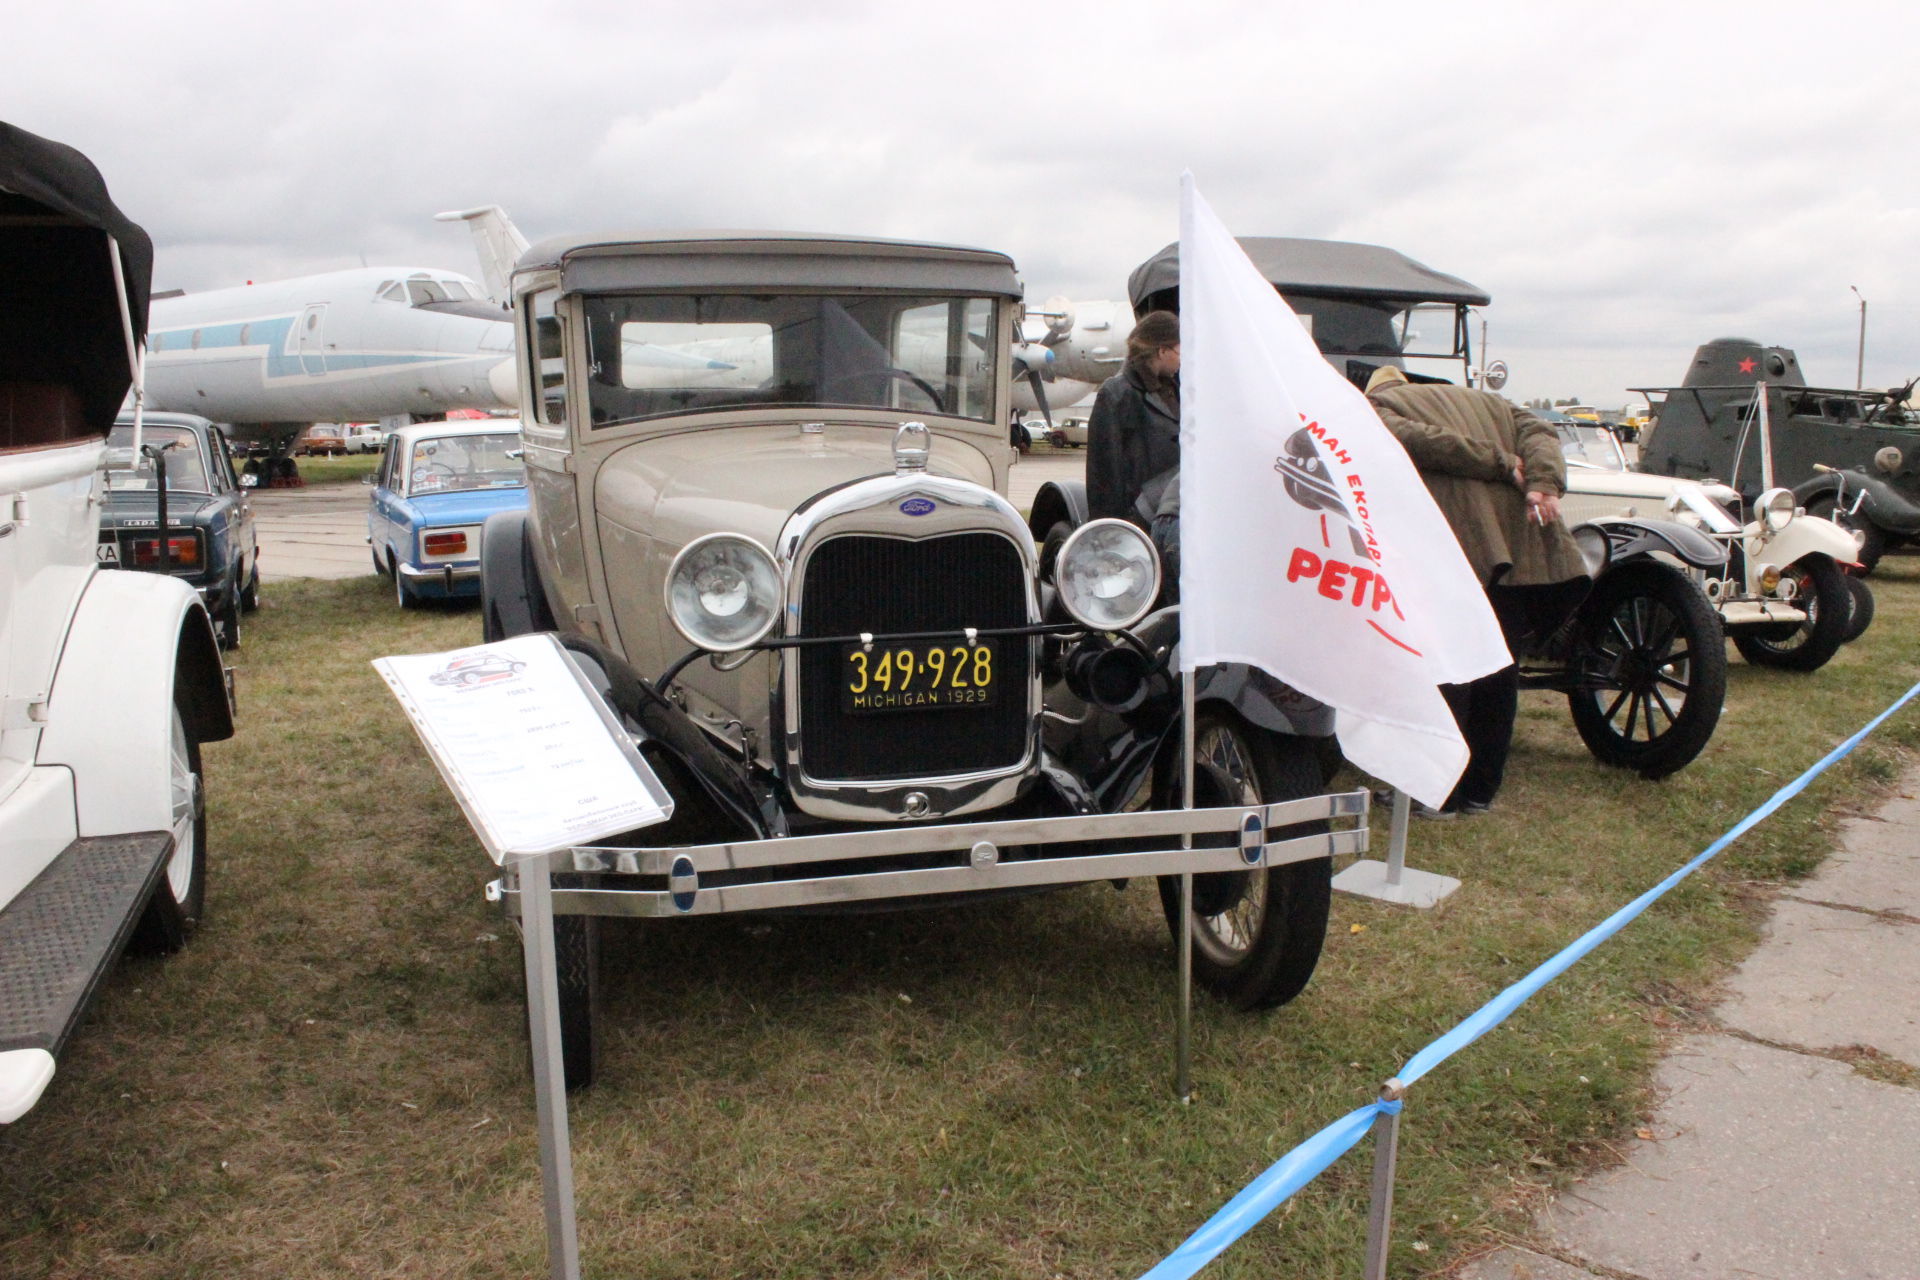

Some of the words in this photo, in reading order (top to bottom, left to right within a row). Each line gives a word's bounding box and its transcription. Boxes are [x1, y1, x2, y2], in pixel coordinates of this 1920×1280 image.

[903, 500, 931, 512] Ford
[1298, 412, 1352, 465] МАН
[1346, 474, 1381, 568] ЕКОПАР
[1287, 547, 1405, 621] РЕТР
[854, 691, 938, 709] MICHIGAN
[947, 689, 987, 703] 1929
